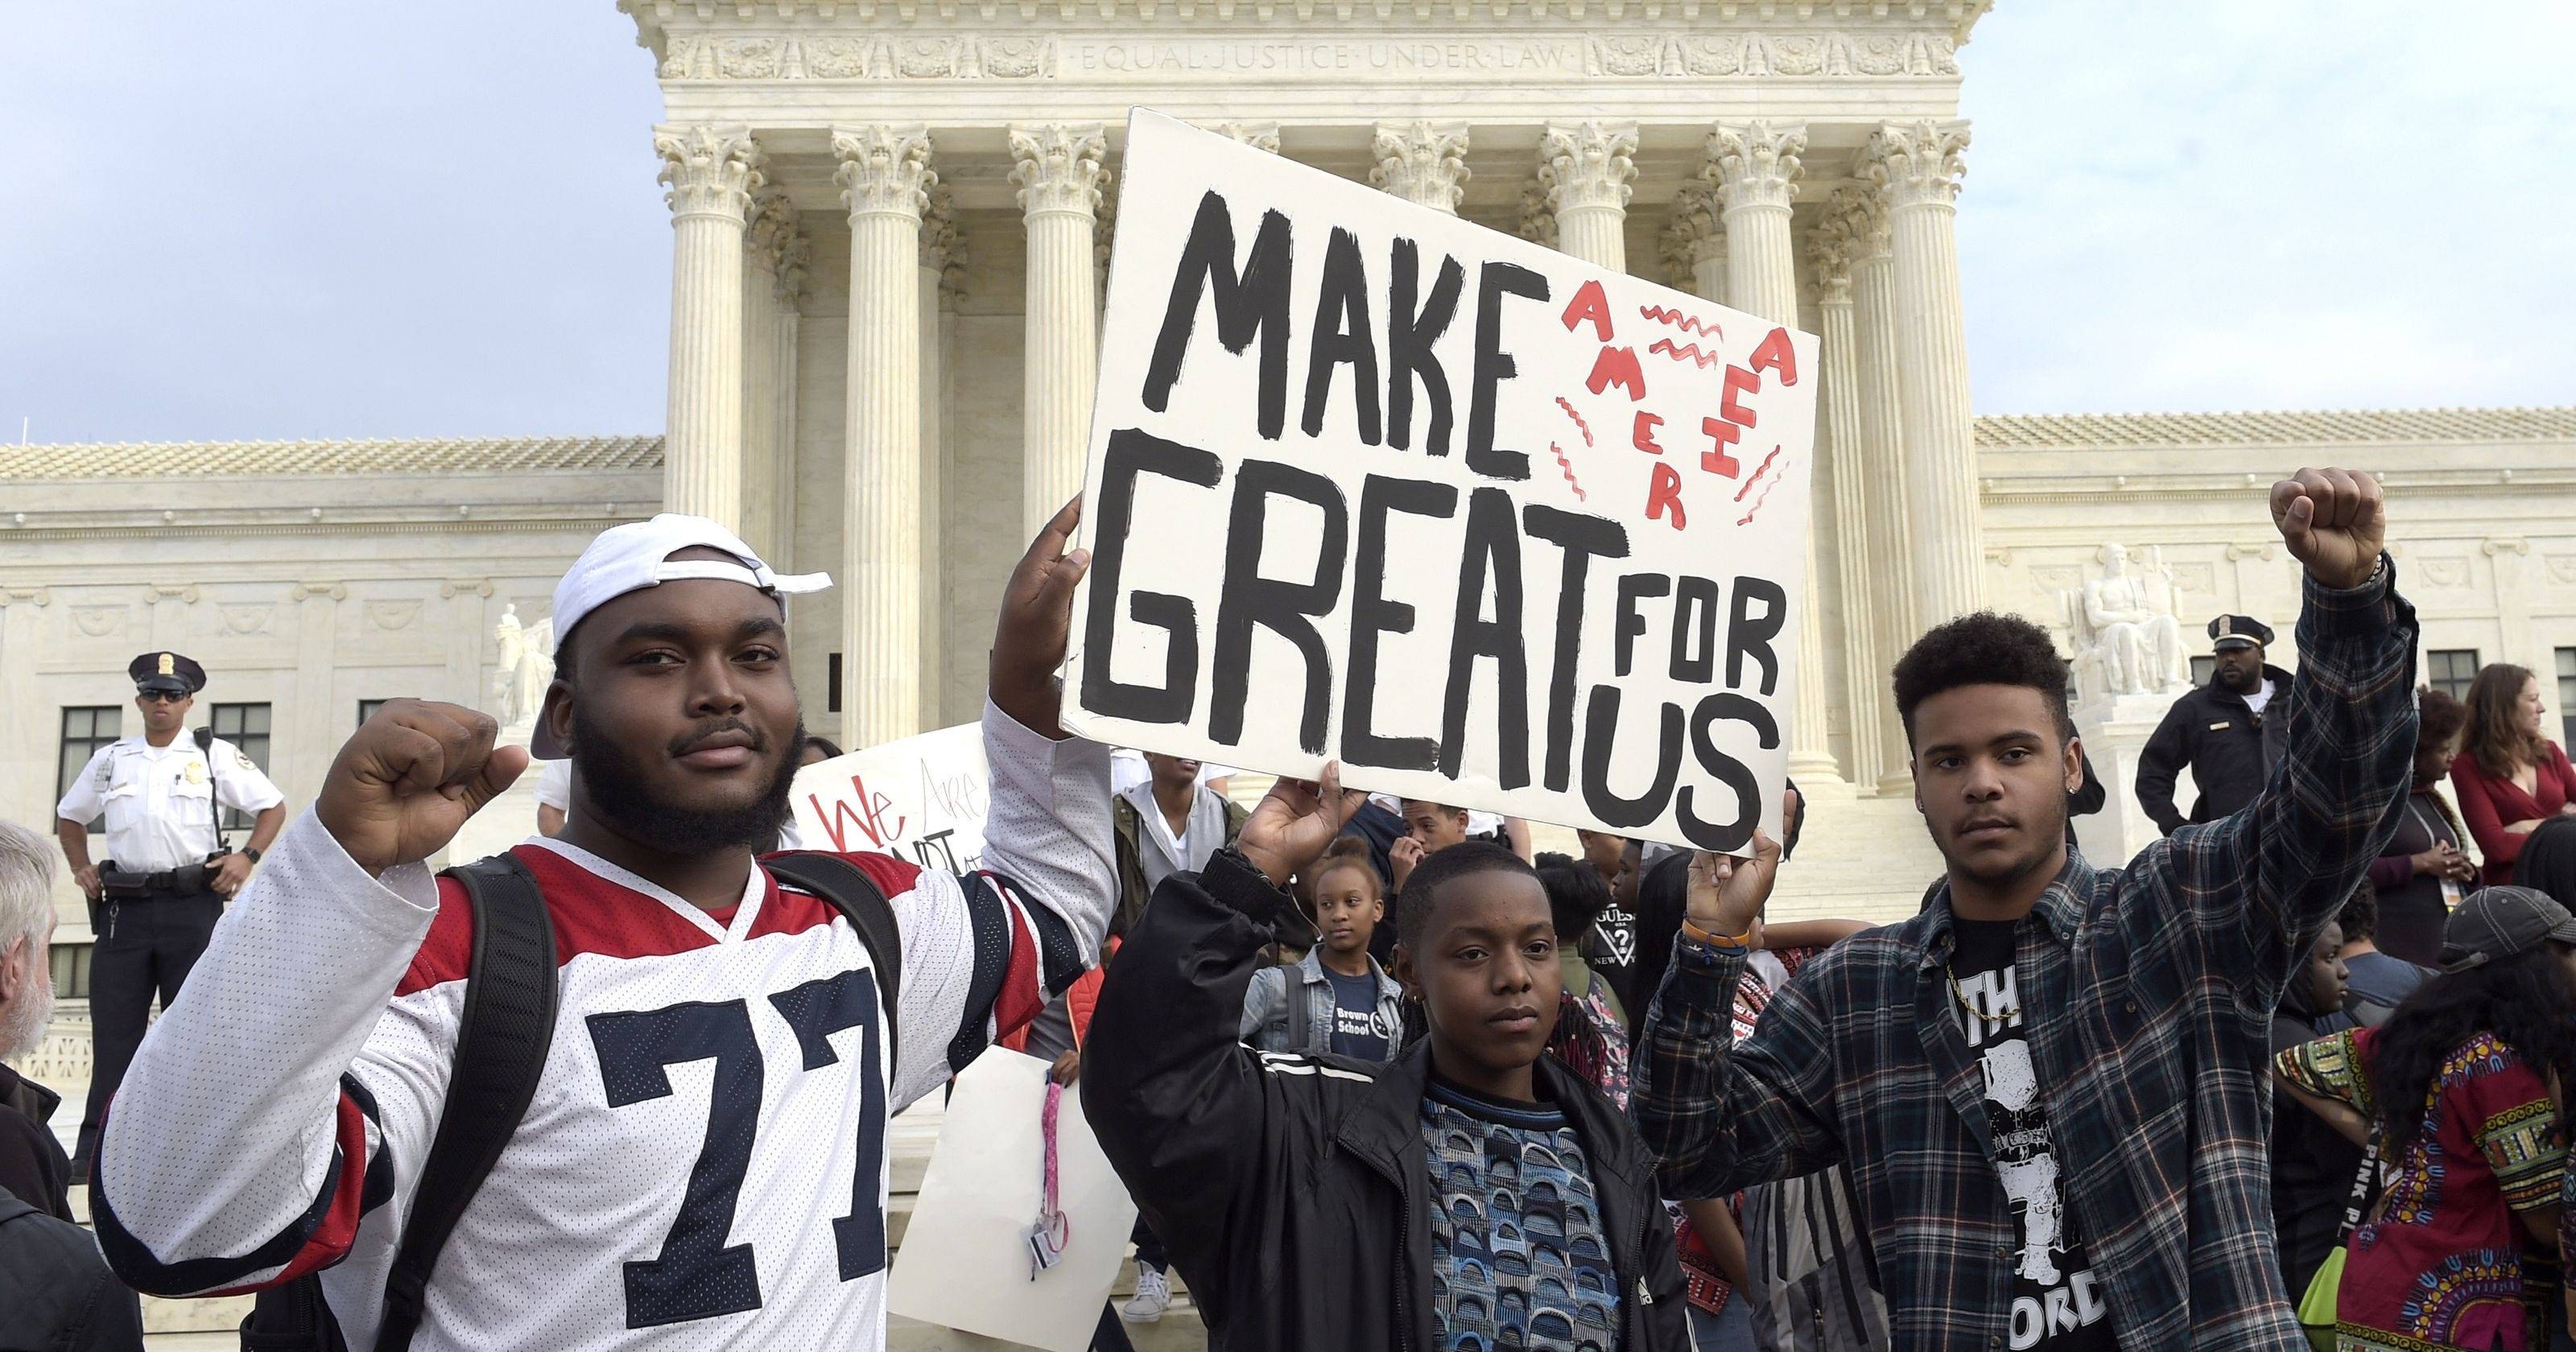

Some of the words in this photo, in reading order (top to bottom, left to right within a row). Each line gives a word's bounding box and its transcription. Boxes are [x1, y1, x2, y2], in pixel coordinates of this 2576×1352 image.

[1082, 45, 1203, 72] EQUAL
[1212, 45, 1349, 69] JUSTICE
[1368, 45, 1488, 68] UNDER
[1499, 45, 1566, 68] LAW
[1141, 188, 1551, 482] MAKE
[1080, 427, 1632, 793] GREAT
[1615, 573, 1787, 697] FOR
[1581, 684, 1781, 852] US
[1336, 1008, 1368, 1021] Brown
[1338, 1020, 1370, 1036] School
[584, 967, 886, 1329] 77
[2351, 1144, 2378, 1200] PINK
